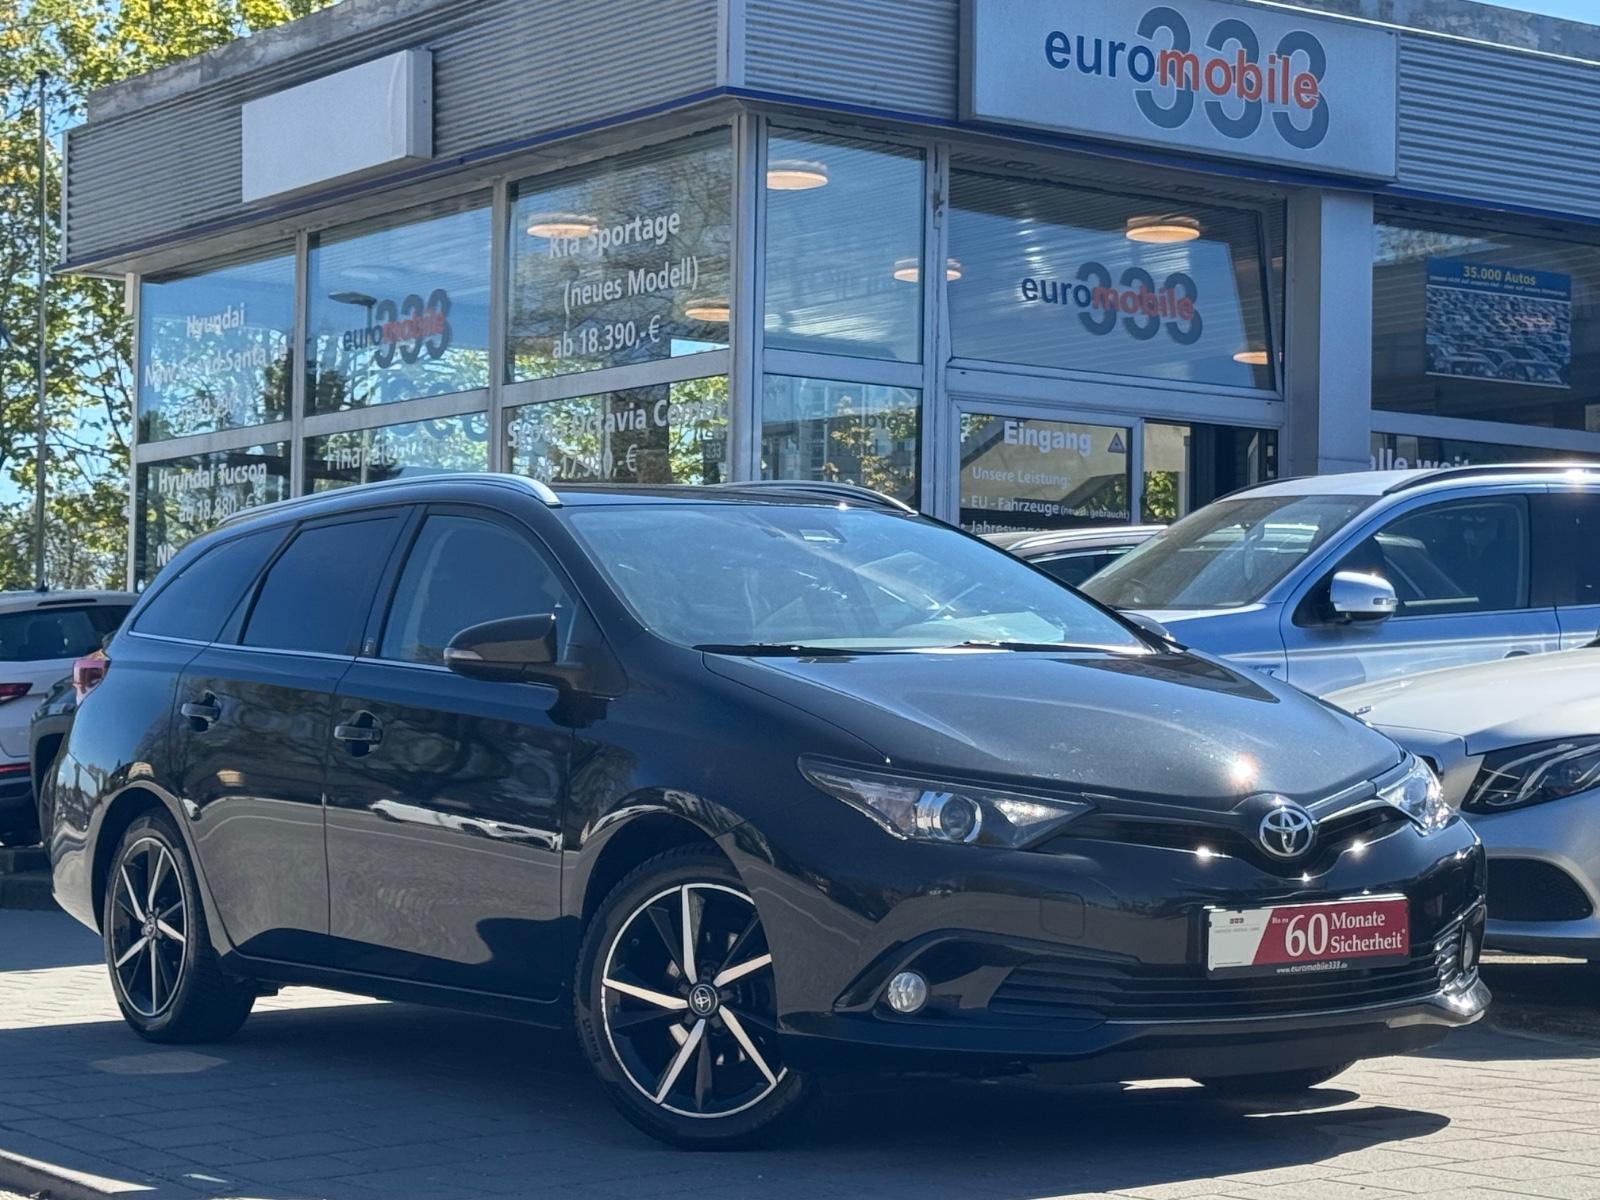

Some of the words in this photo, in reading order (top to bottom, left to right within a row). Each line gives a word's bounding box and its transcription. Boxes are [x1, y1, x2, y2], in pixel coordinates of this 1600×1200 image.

[1044, 29, 1320, 110] euromobile
[1132, 6, 1331, 150] 333
[589, 213, 681, 257] Sportage
[563, 279, 622, 315] (neues
[627, 256, 699, 296] Modell)
[1462, 265, 1502, 281] 35.000
[1504, 271, 1537, 286] Autos
[1020, 276, 1195, 321] euromobile
[1075, 261, 1203, 346] 333
[186, 302, 245, 341] Hyundai
[374, 288, 452, 369] 333
[552, 331, 573, 359] ab
[572, 402, 647, 438] Octavia
[1003, 420, 1092, 457] Eingang
[158, 464, 215, 494] Hyundai
[218, 462, 267, 486] Tucson
[972, 467, 1016, 482] Unsere
[971, 495, 987, 509] EU
[998, 497, 1060, 516] Fahrzeuge
[1285, 913, 1329, 957] 60
[1330, 911, 1386, 930] Monate
